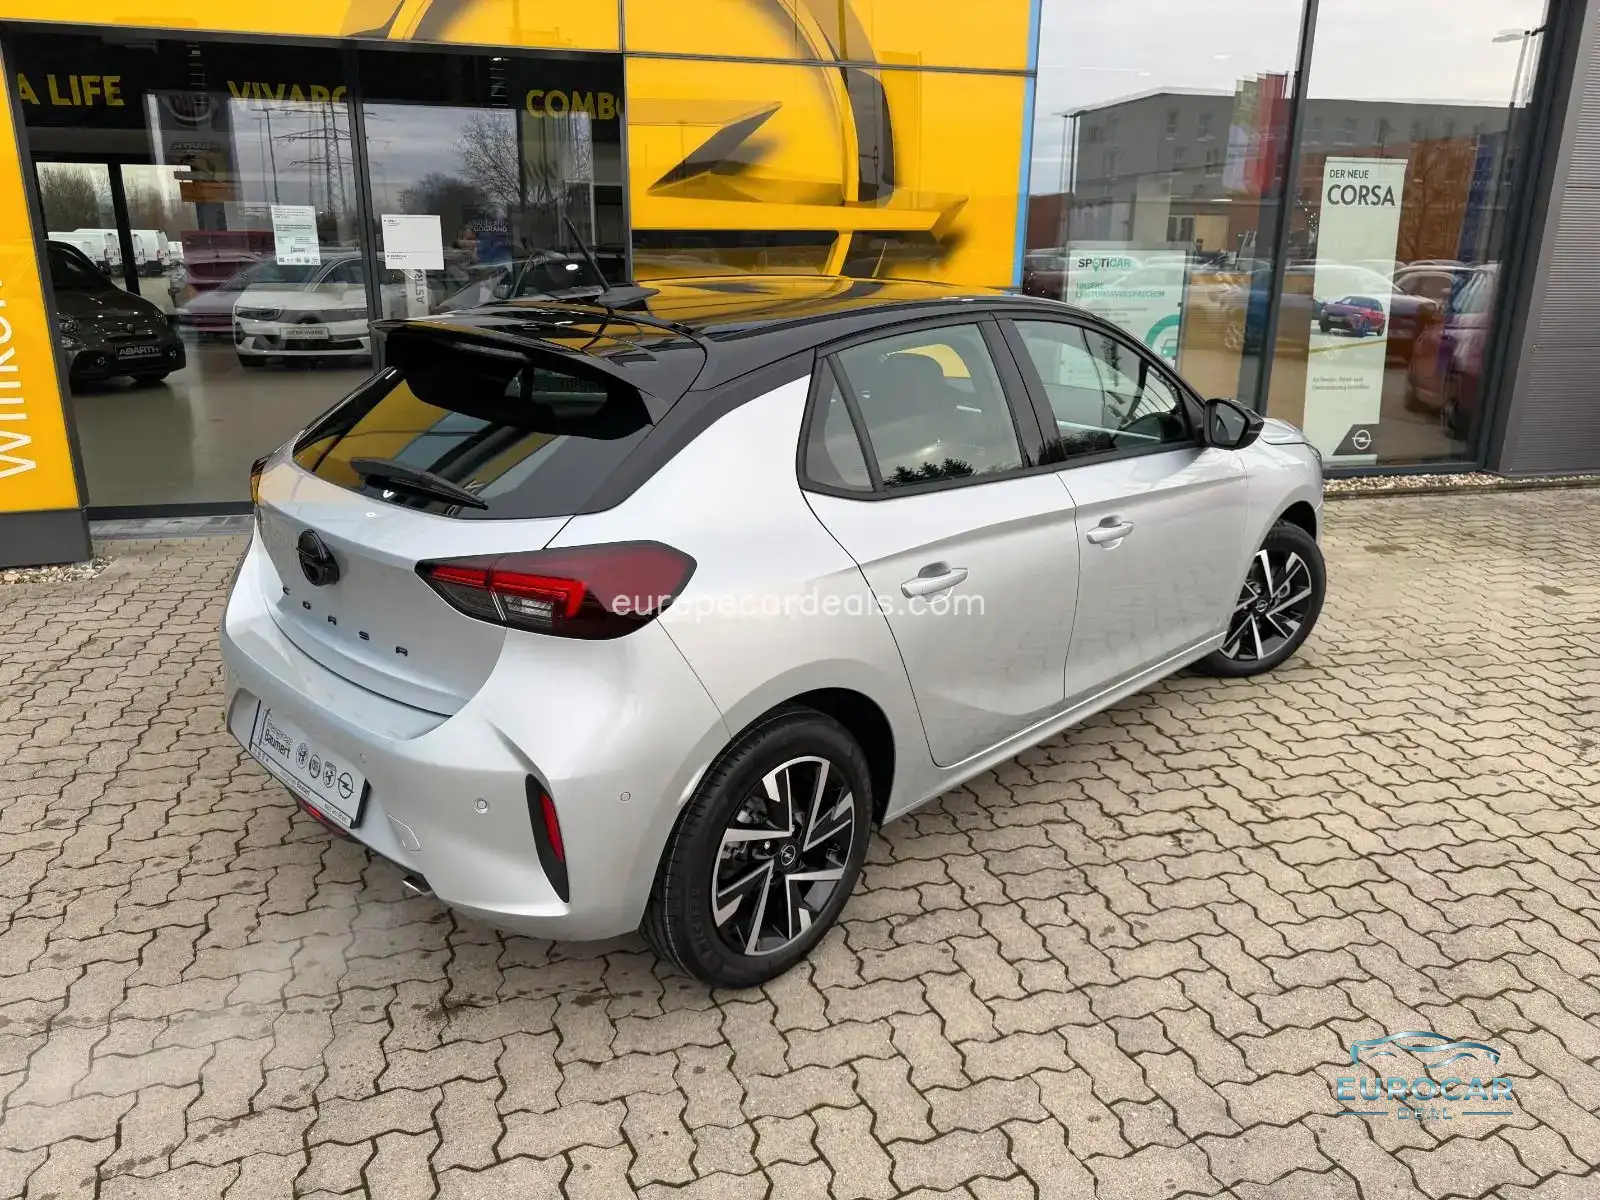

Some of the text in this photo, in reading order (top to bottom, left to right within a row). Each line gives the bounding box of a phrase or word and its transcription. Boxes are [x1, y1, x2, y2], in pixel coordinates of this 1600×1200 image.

[47, 73, 126, 106] LIFE
[526, 88, 620, 120] COMB
[1329, 168, 1370, 179] DER NEUE
[1327, 184, 1396, 206] CORSA
[119, 346, 159, 355] ABARTH
[264, 729, 291, 759] Baumert
